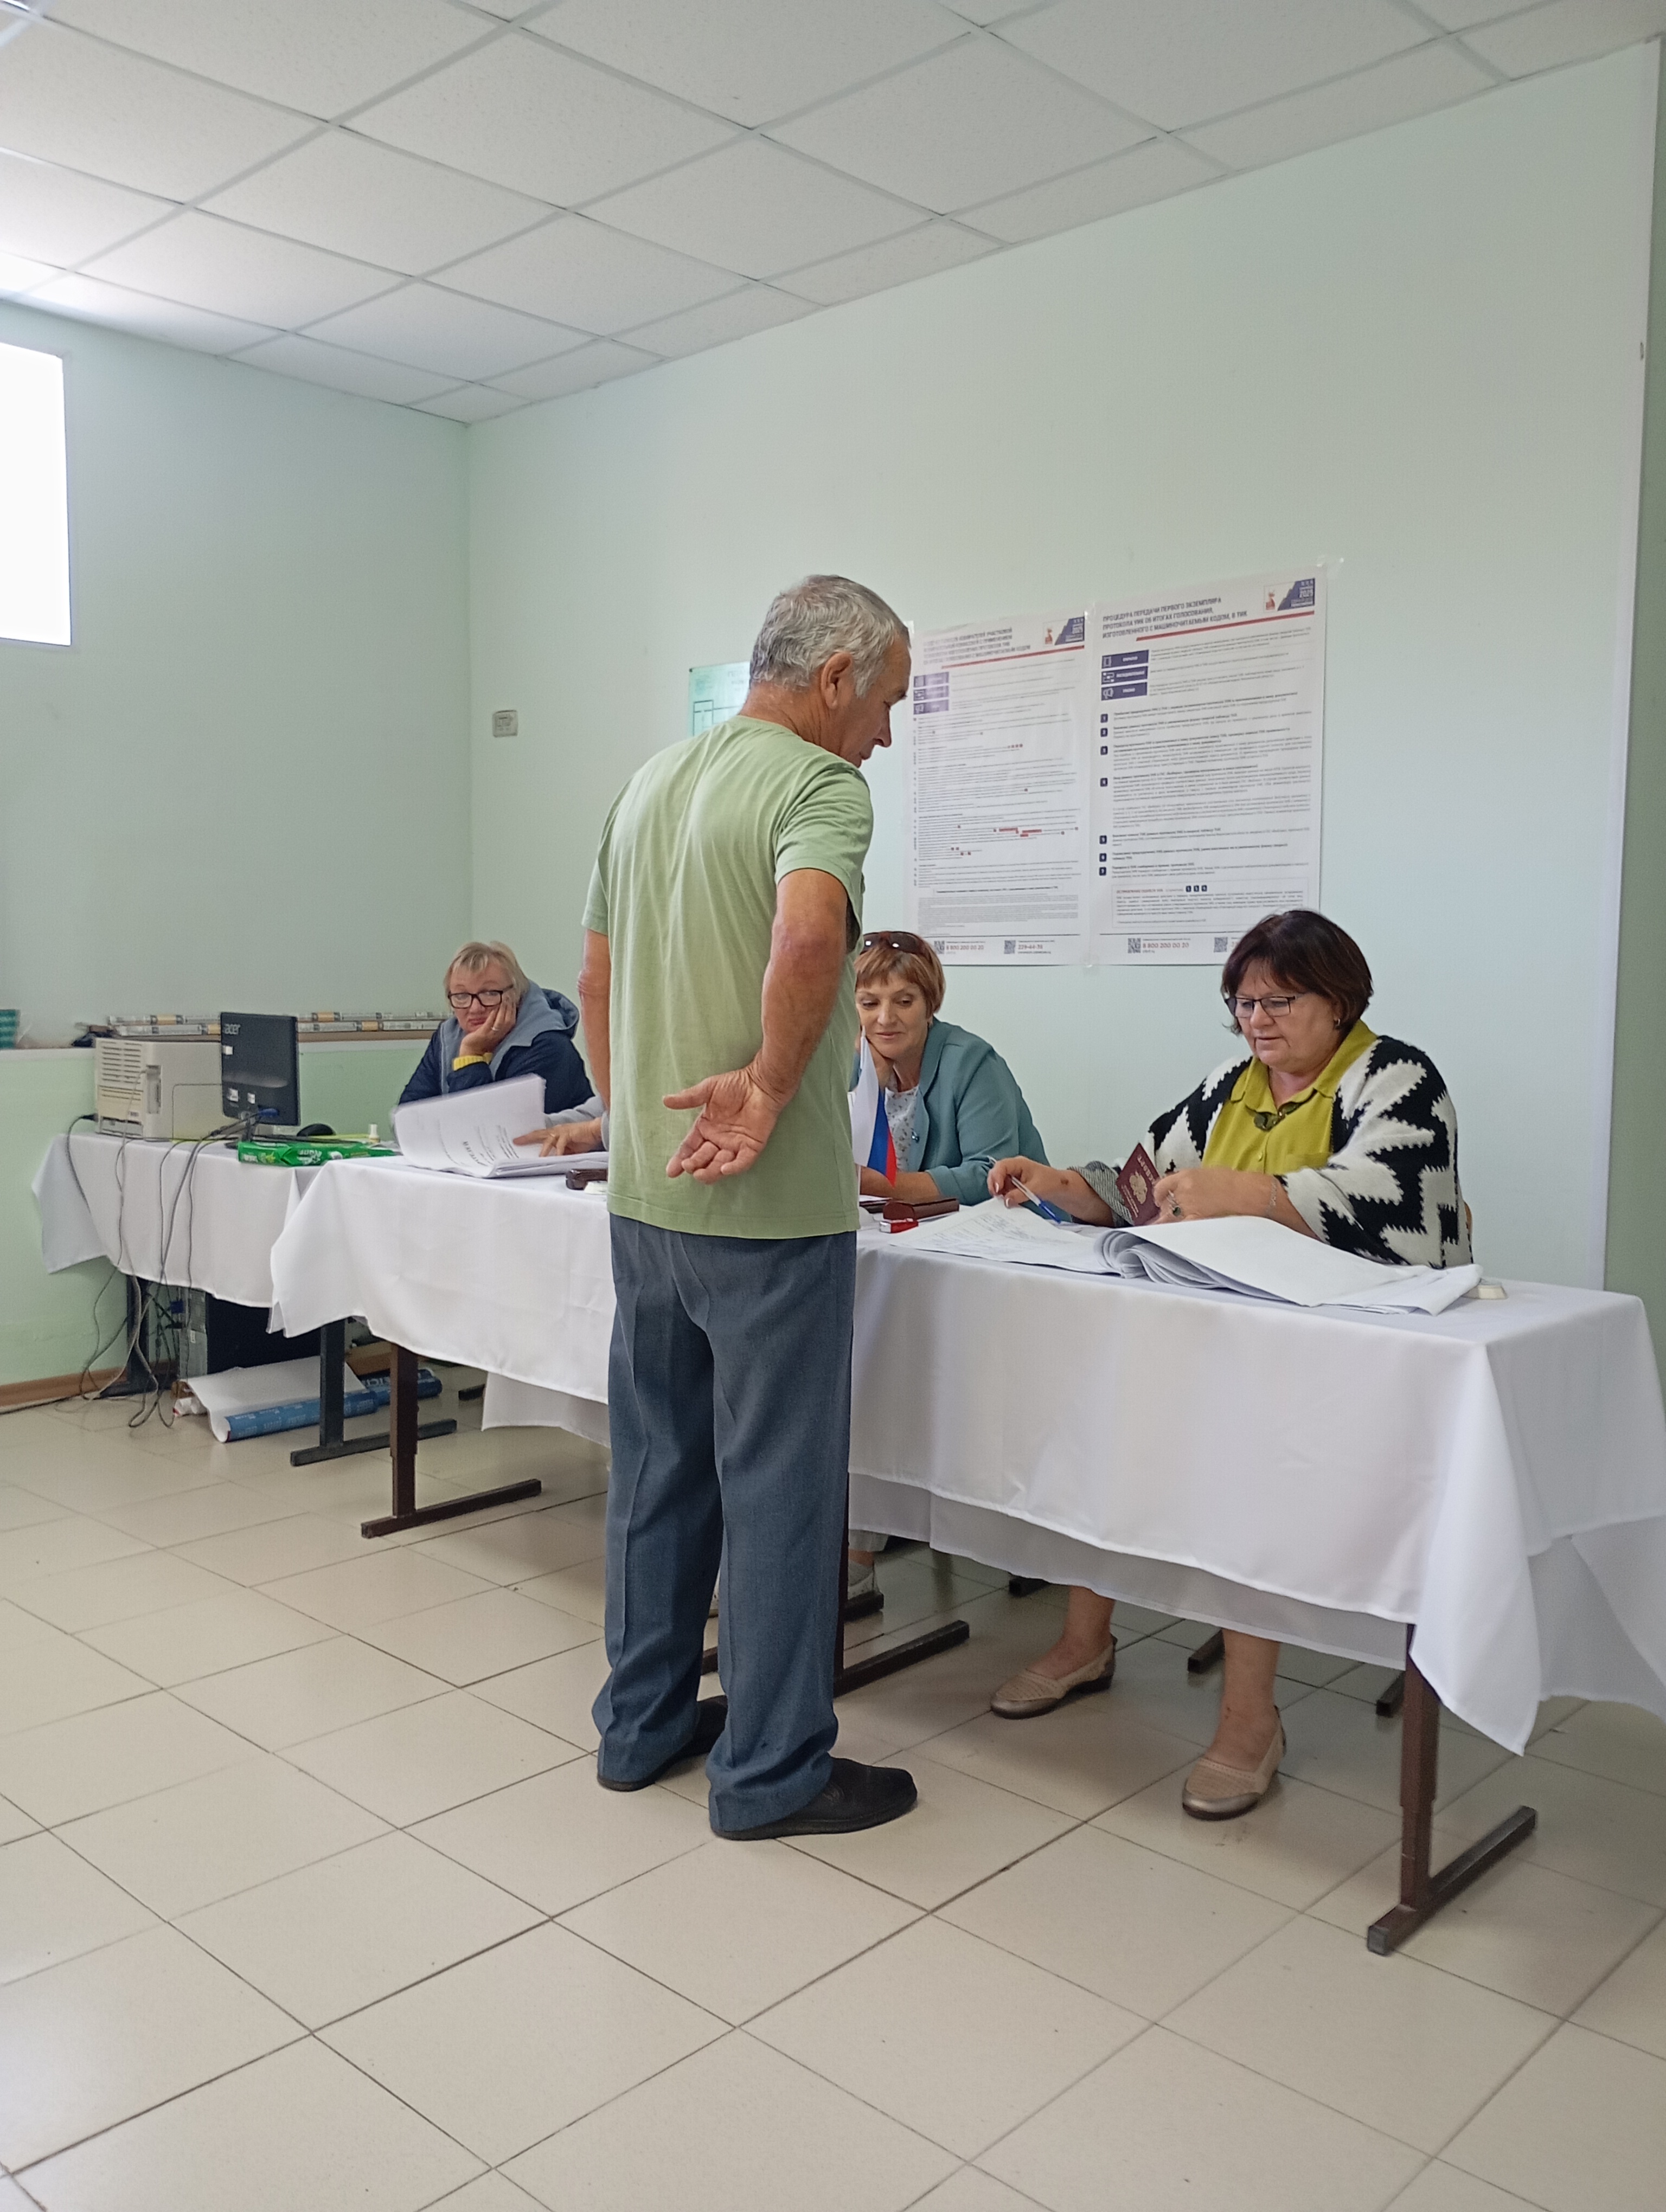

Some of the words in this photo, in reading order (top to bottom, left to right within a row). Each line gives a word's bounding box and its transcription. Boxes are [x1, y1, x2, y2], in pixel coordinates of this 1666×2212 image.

[1103, 612, 1132, 622] ПРОЦЕДУРА
[1133, 607, 1160, 616] ПЕРЕДАЧИ
[1161, 603, 1184, 613] ПЕРВОГО
[1103, 620, 1133, 630] ПРОТОКОЛА
[1152, 614, 1172, 622] ИТОГАХ
[1103, 626, 1149, 639] ИЗГОТОВЛЕННОГО
[224, 1023, 241, 1034] acer
